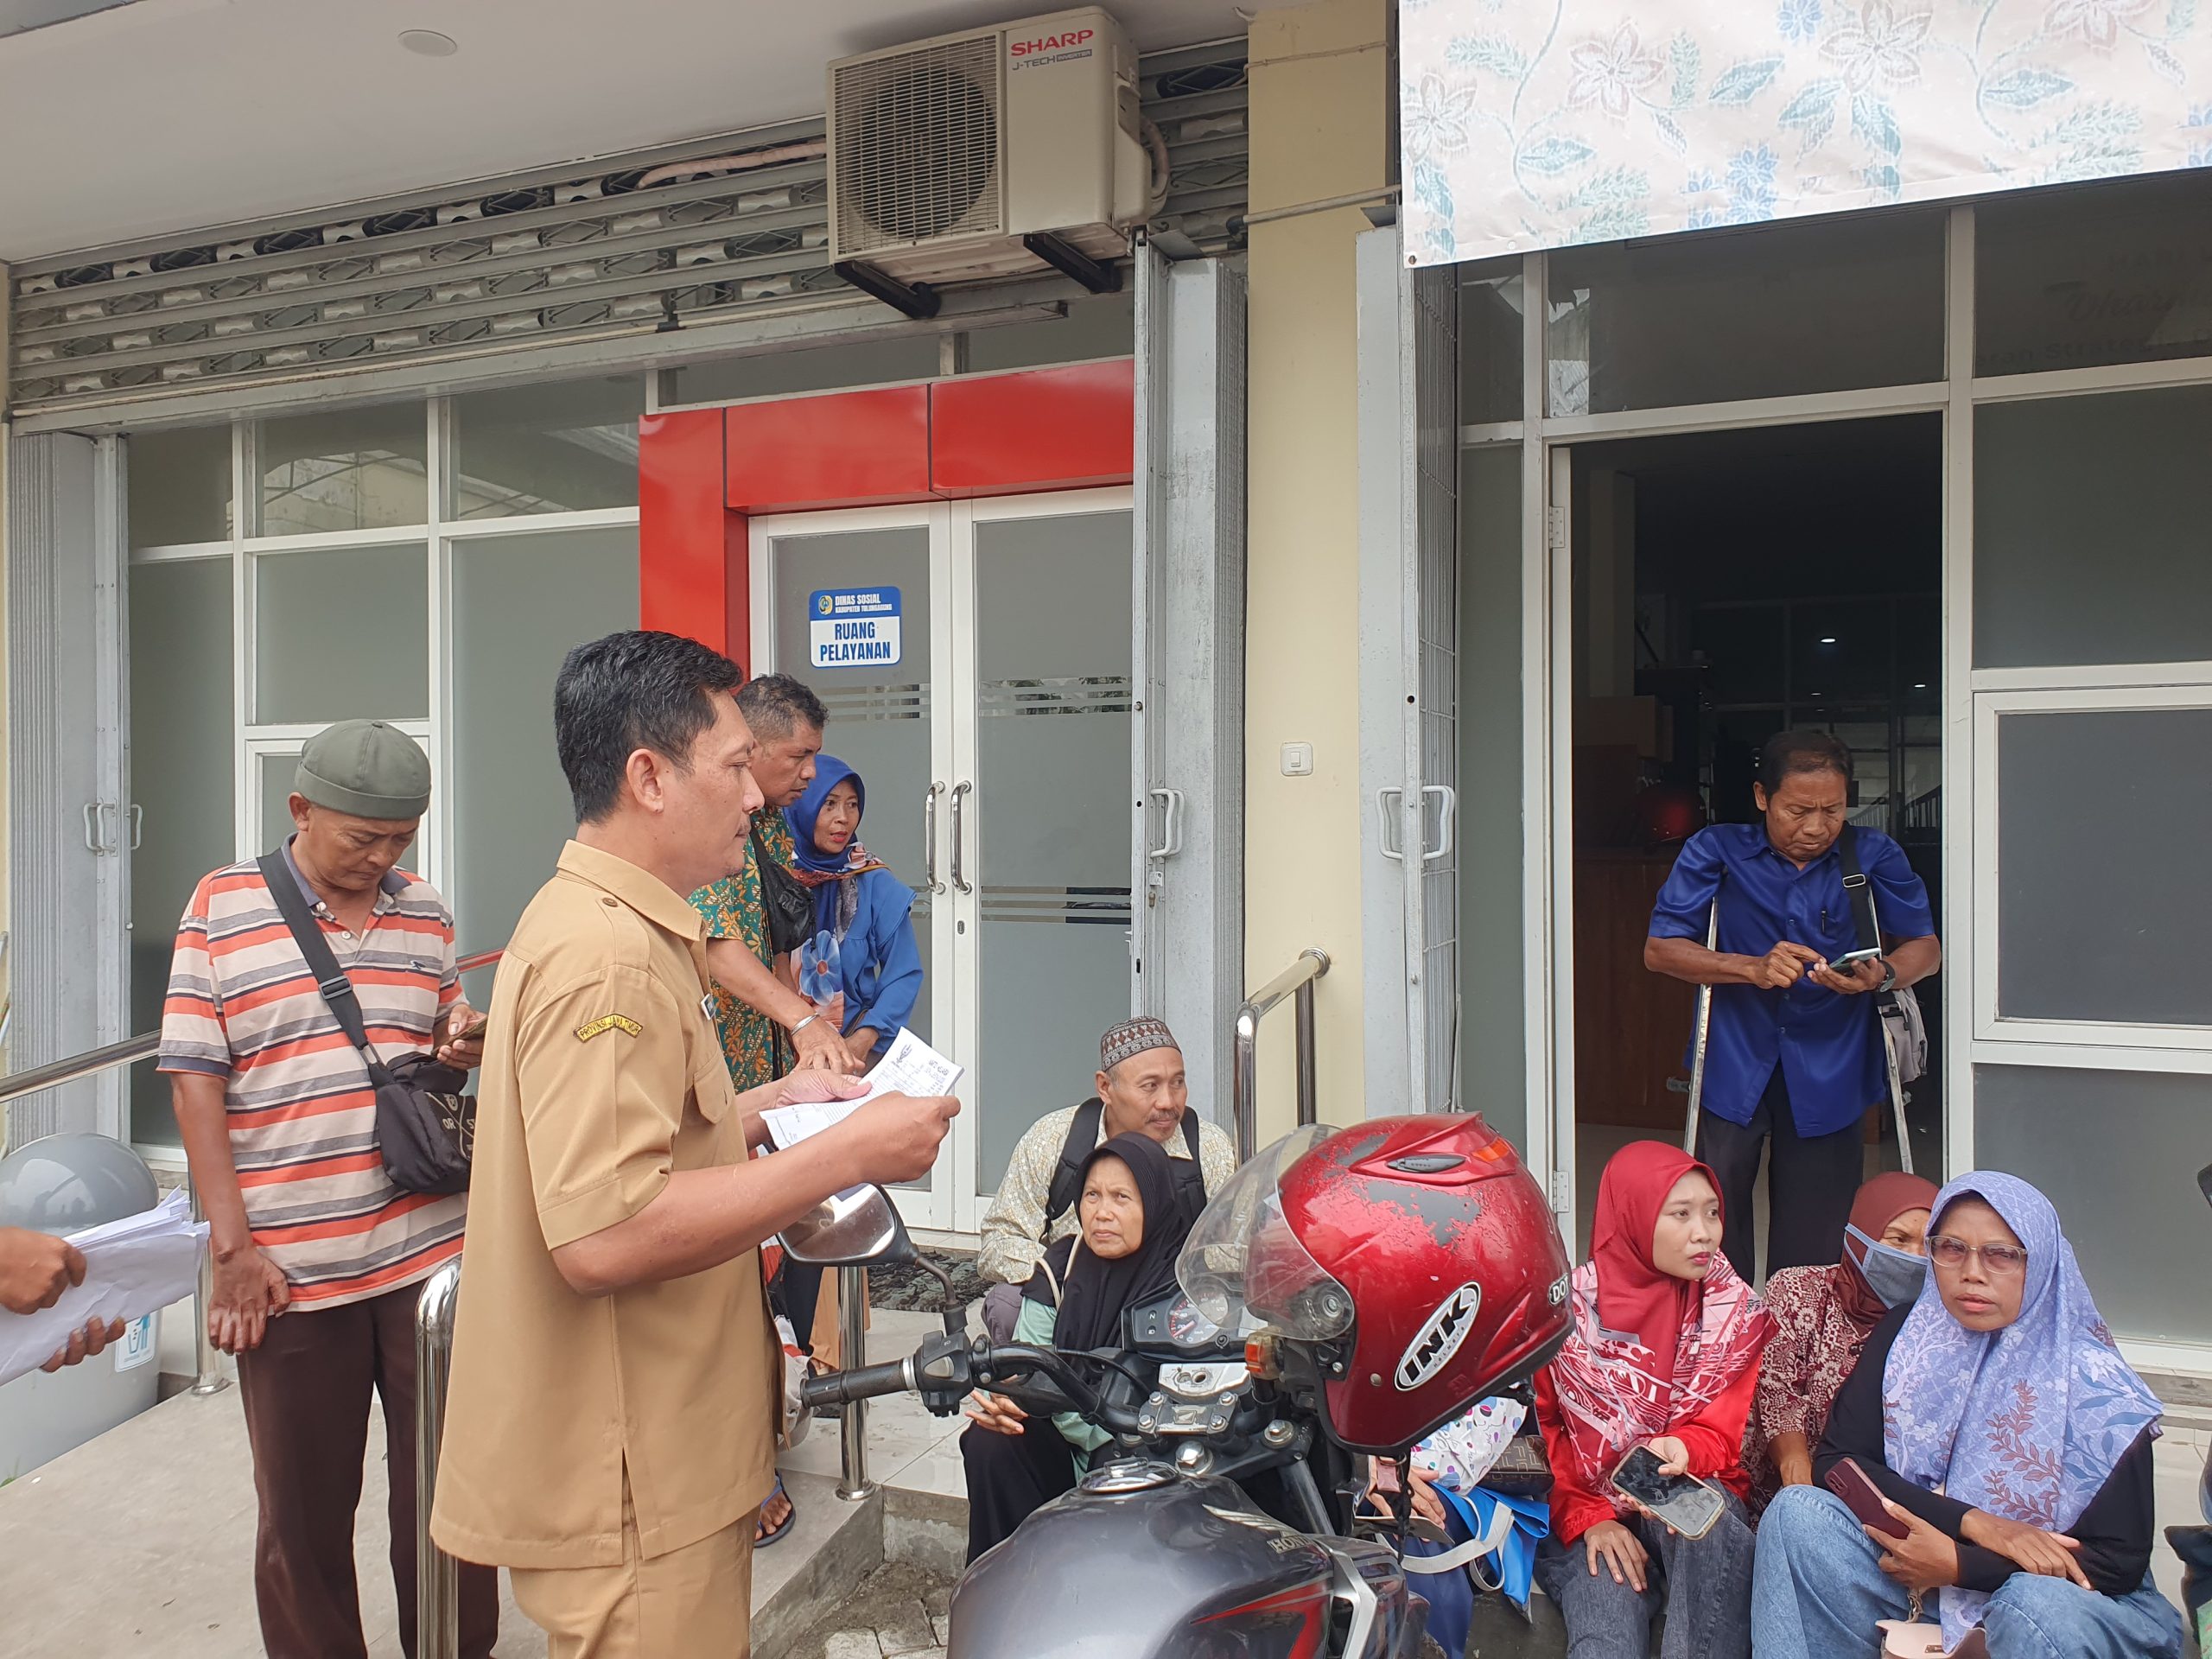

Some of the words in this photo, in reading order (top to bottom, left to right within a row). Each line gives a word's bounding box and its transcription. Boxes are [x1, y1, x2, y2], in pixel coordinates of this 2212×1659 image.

[1010, 29, 1094, 56] SHARP
[1012, 55, 1056, 71] J-TECH
[835, 594, 856, 606] DINAS
[856, 594, 881, 604] SOSIAL
[835, 622, 875, 640] RUANG
[820, 642, 890, 661] PELAYANAN
[1402, 1291, 1472, 1383] INK
